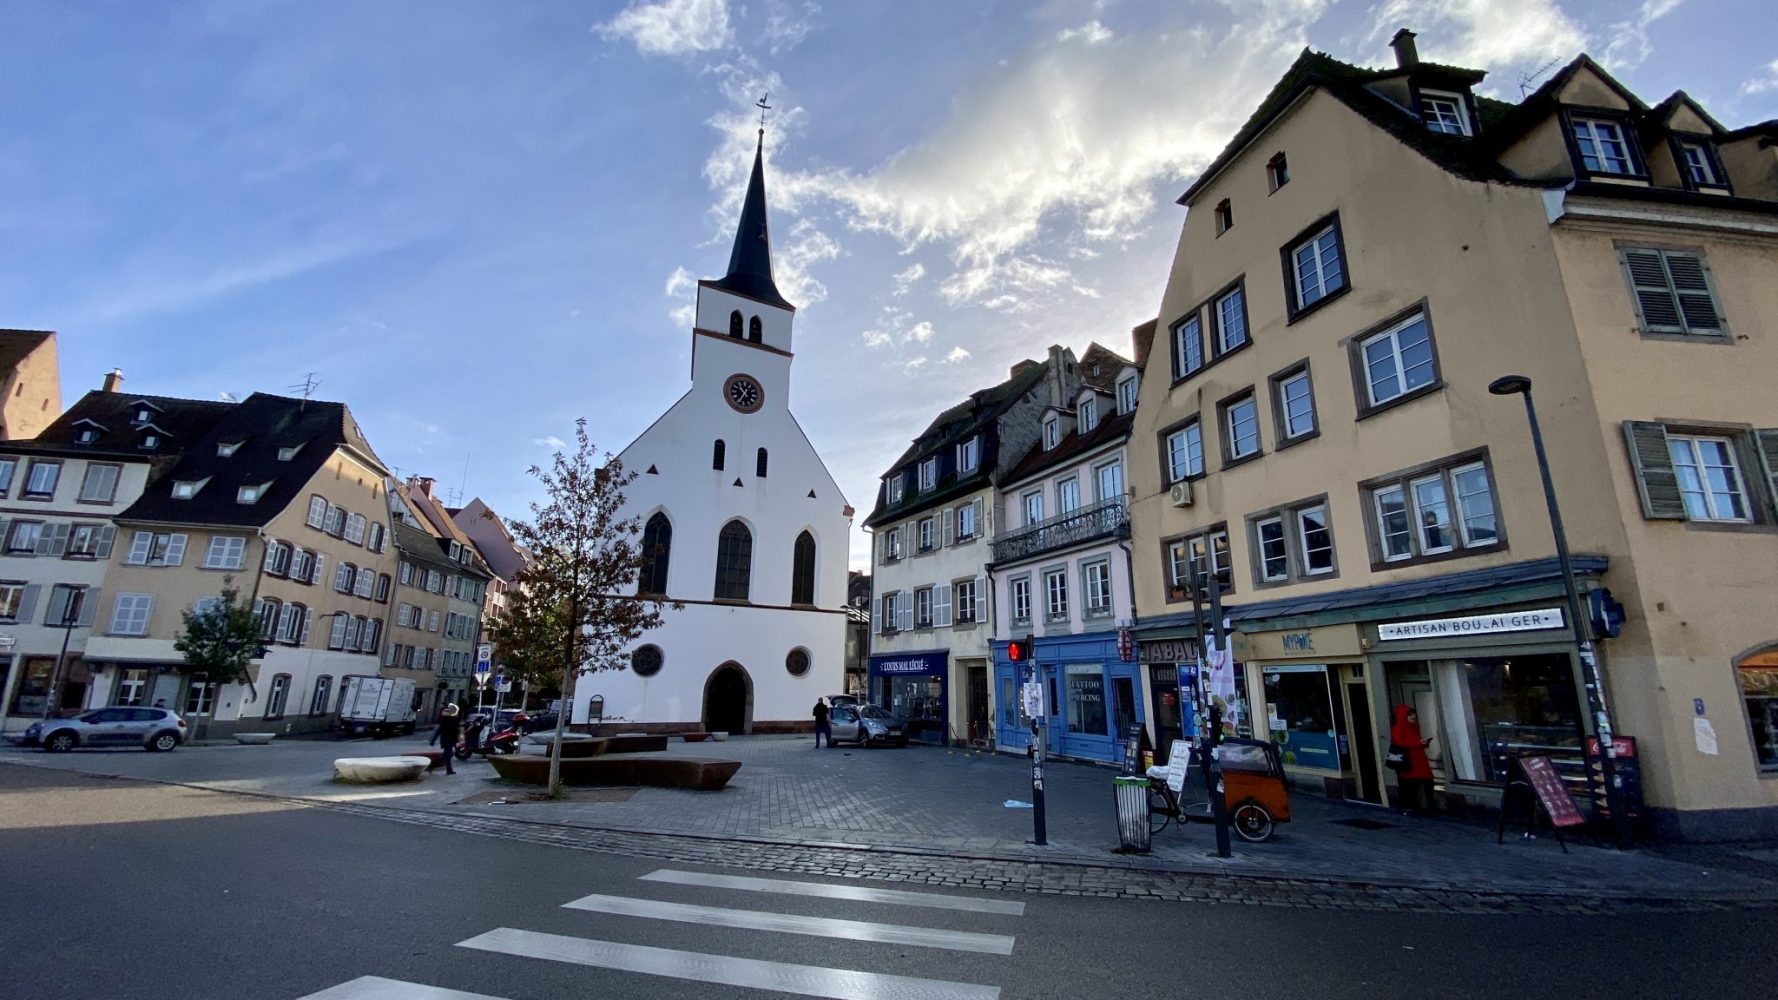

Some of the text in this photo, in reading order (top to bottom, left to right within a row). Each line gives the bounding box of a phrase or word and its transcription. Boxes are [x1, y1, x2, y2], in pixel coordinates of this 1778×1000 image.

[1396, 622, 1447, 636] ARTISAN
[1142, 639, 1198, 660] TABAC
[899, 661, 909, 671] MAL
[1070, 680, 1100, 689] TATTOO
[1069, 693, 1101, 702] PIERCING
